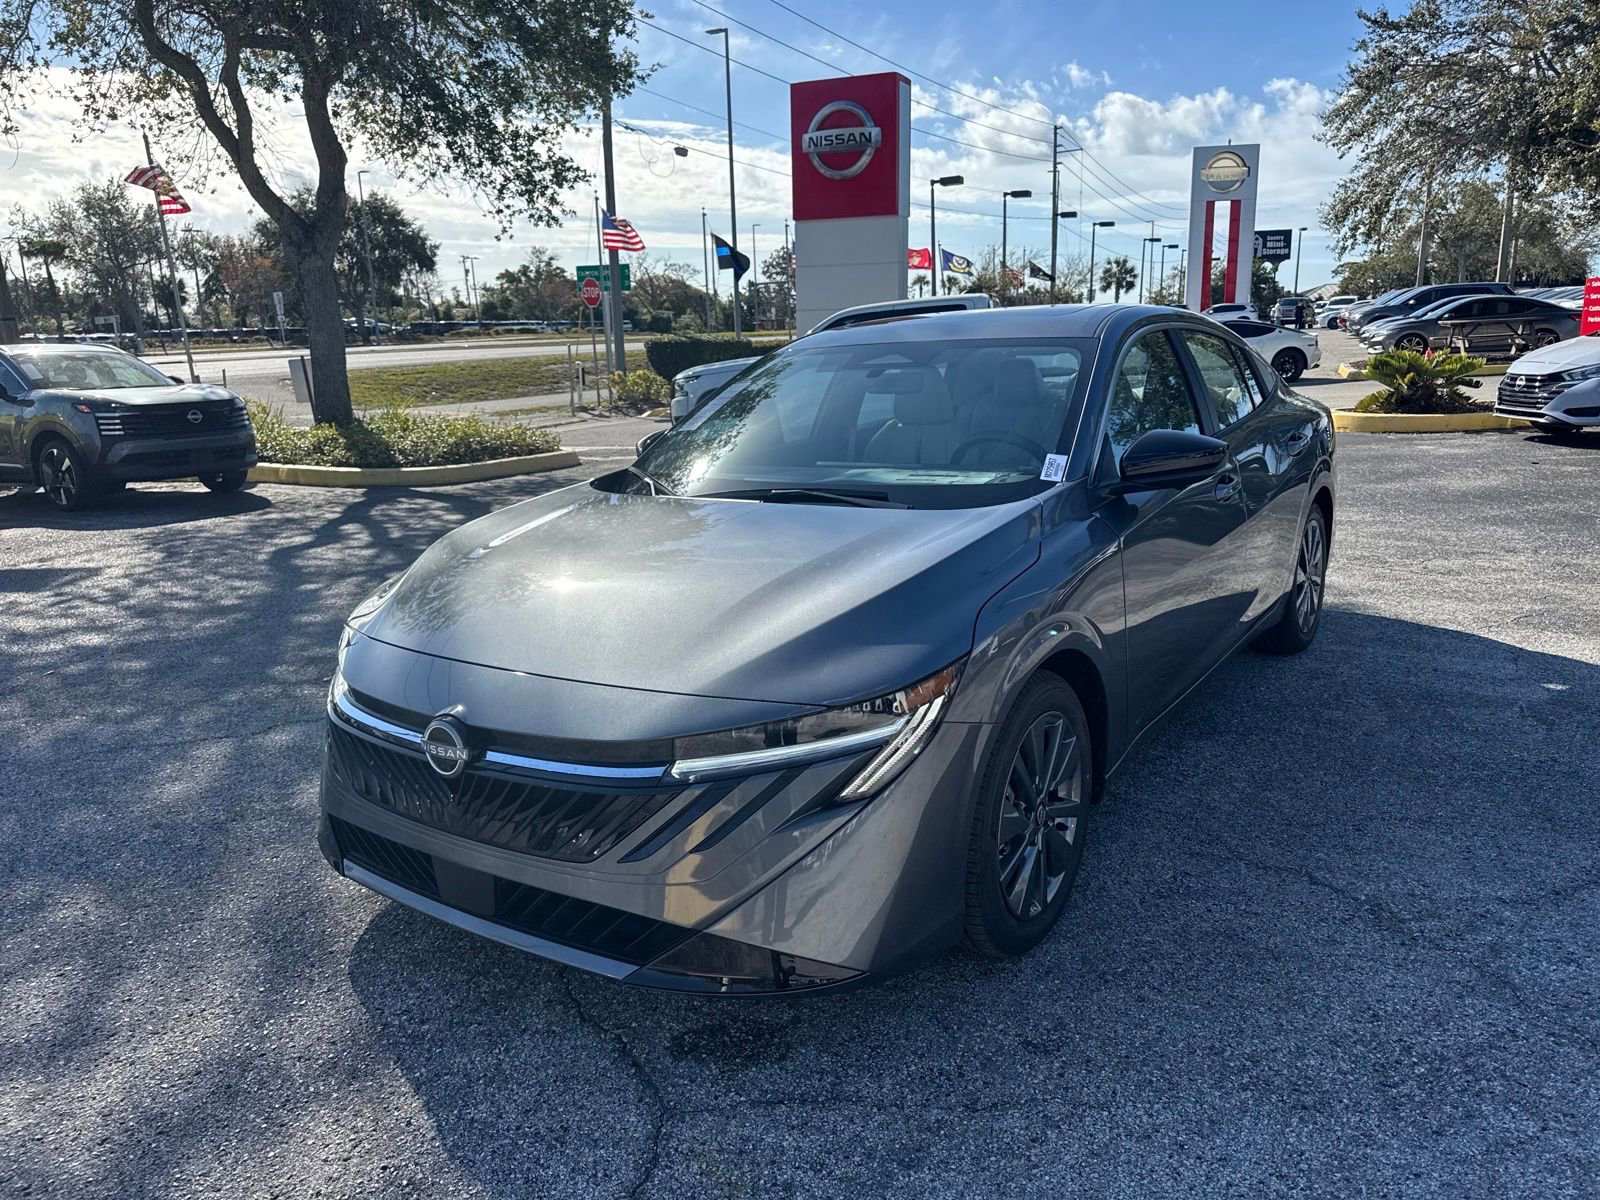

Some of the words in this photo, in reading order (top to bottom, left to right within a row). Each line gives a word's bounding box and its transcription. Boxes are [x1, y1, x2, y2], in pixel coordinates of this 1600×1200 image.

[808, 131, 872, 149] NISSAN
[583, 287, 600, 298] STOP
[421, 741, 466, 760] NISSAN
